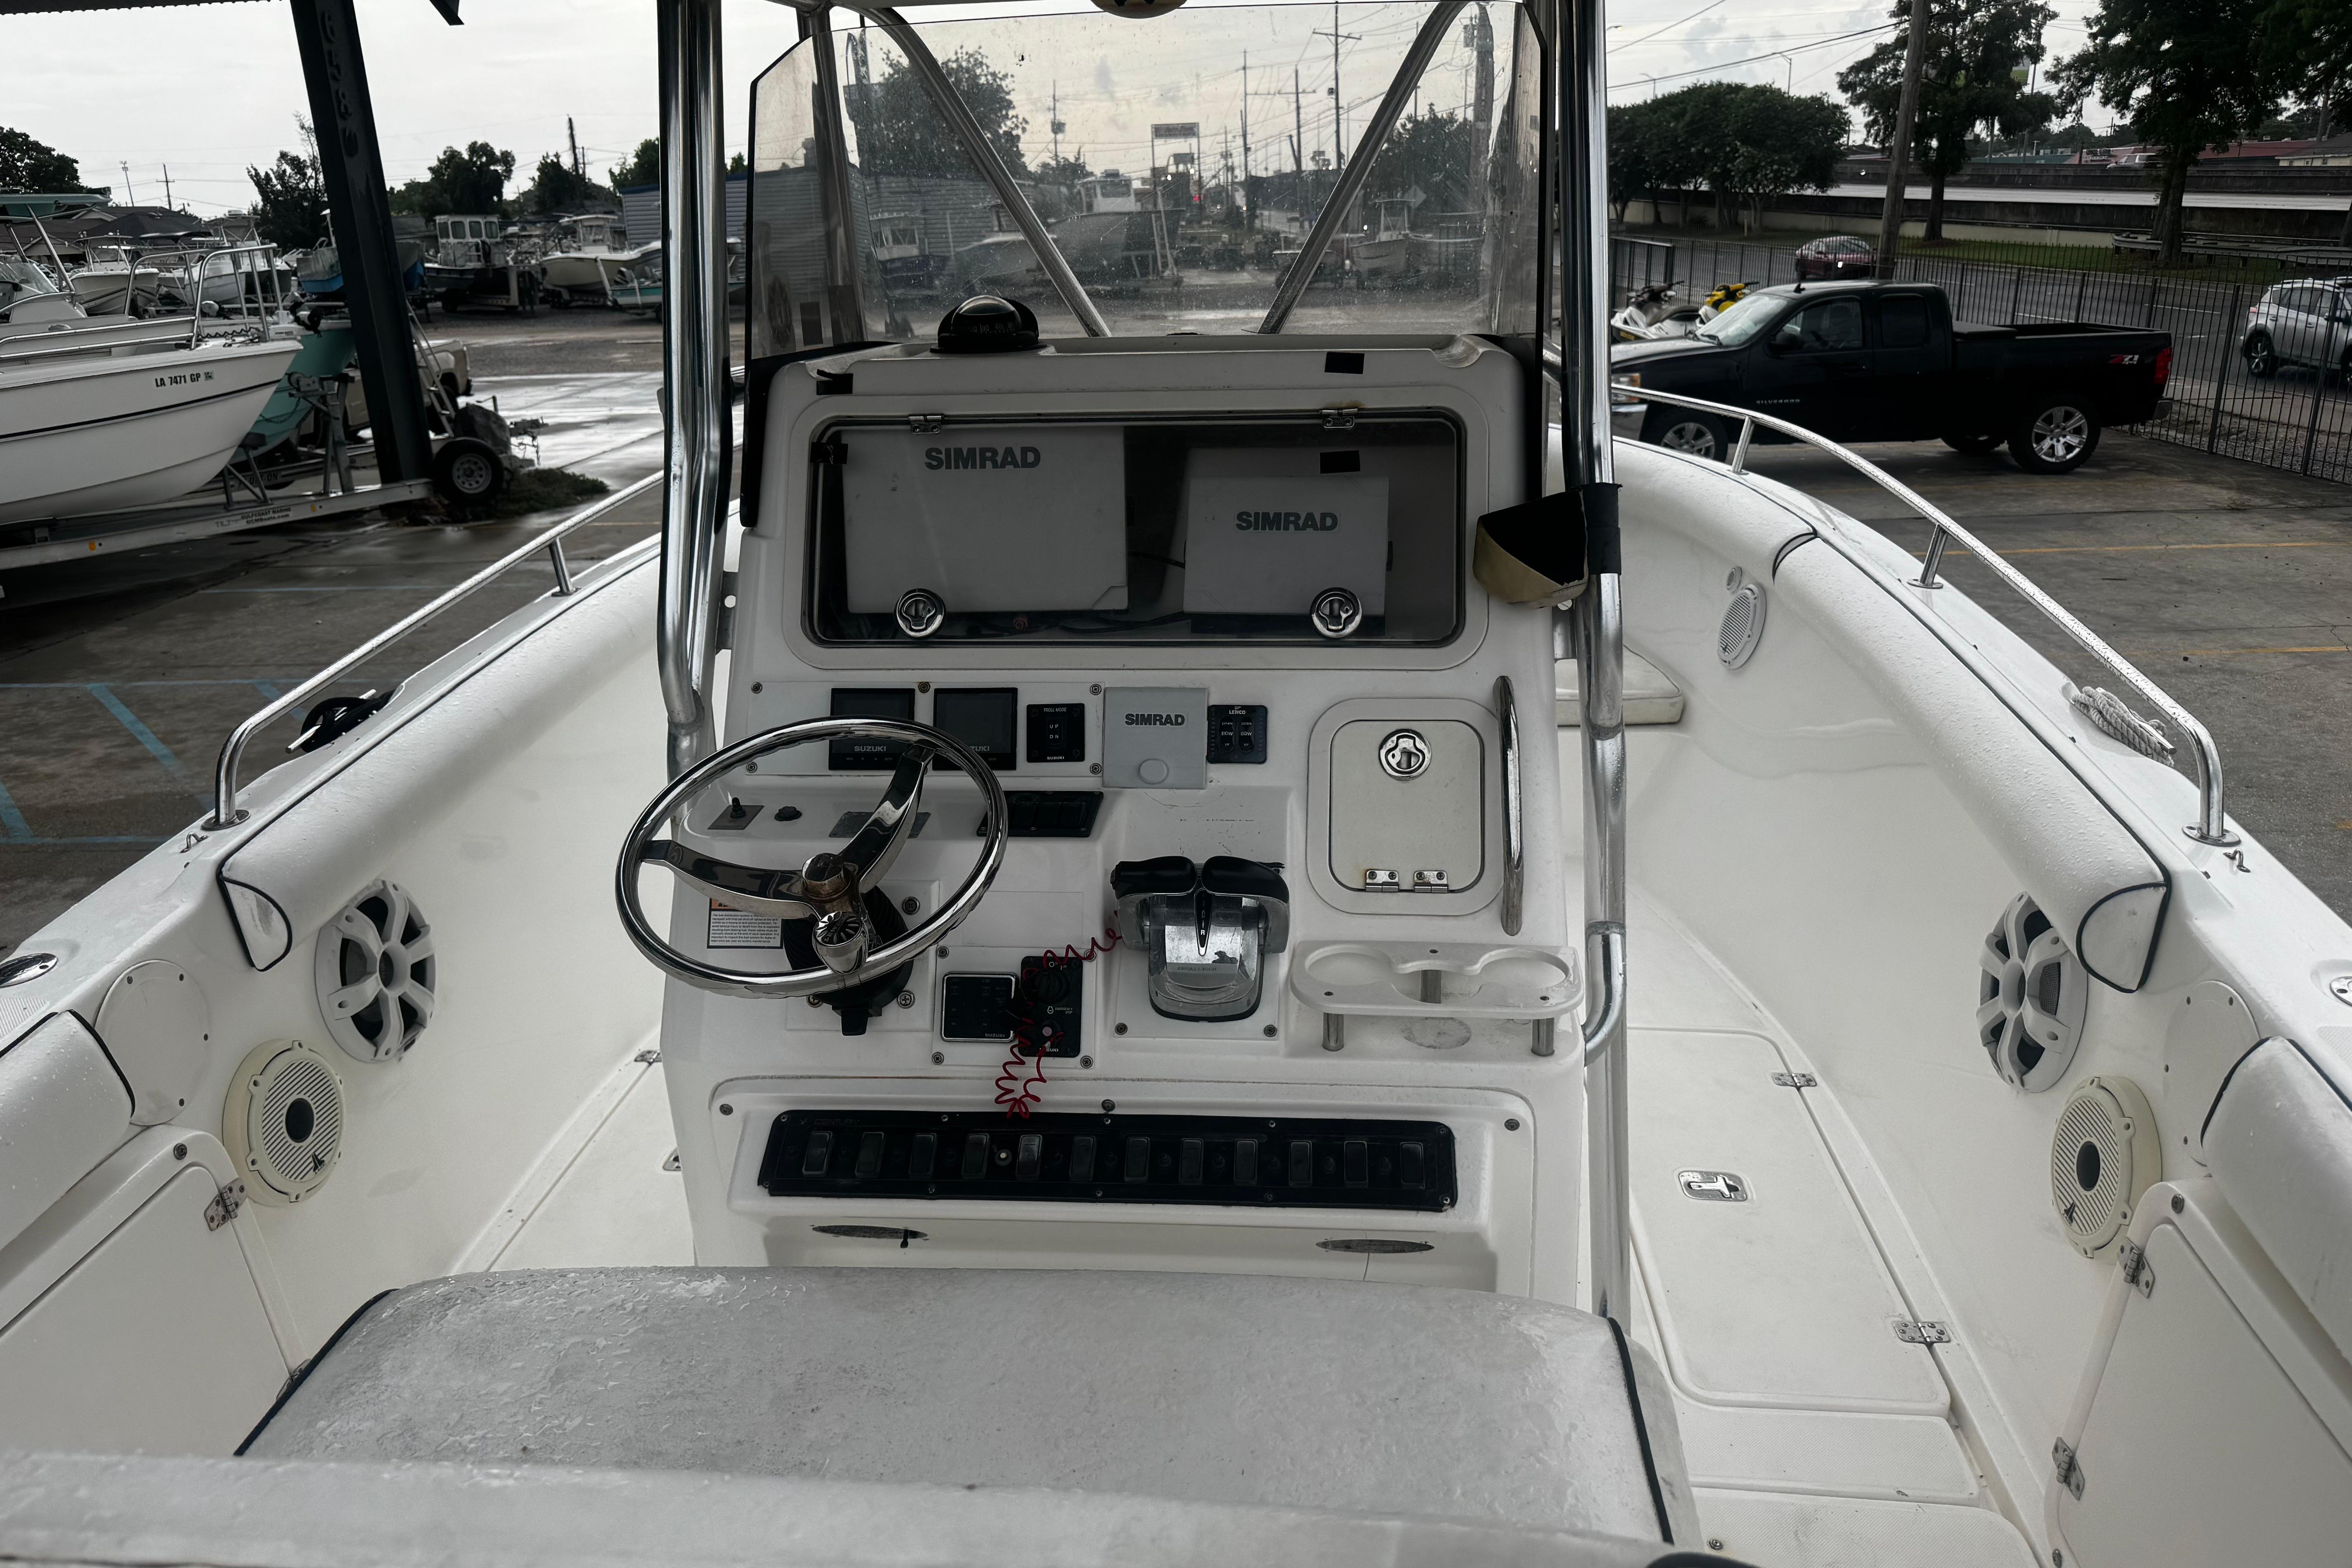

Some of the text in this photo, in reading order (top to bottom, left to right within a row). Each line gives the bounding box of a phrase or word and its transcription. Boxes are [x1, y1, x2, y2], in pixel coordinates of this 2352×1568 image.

[155, 378, 166, 387] LA
[168, 375, 187, 385] 7471
[190, 373, 201, 383] GP
[925, 446, 1041, 470] SIMRAD
[1236, 511, 1338, 532] SIMRAD
[1125, 713, 1185, 726] SIMRAD
